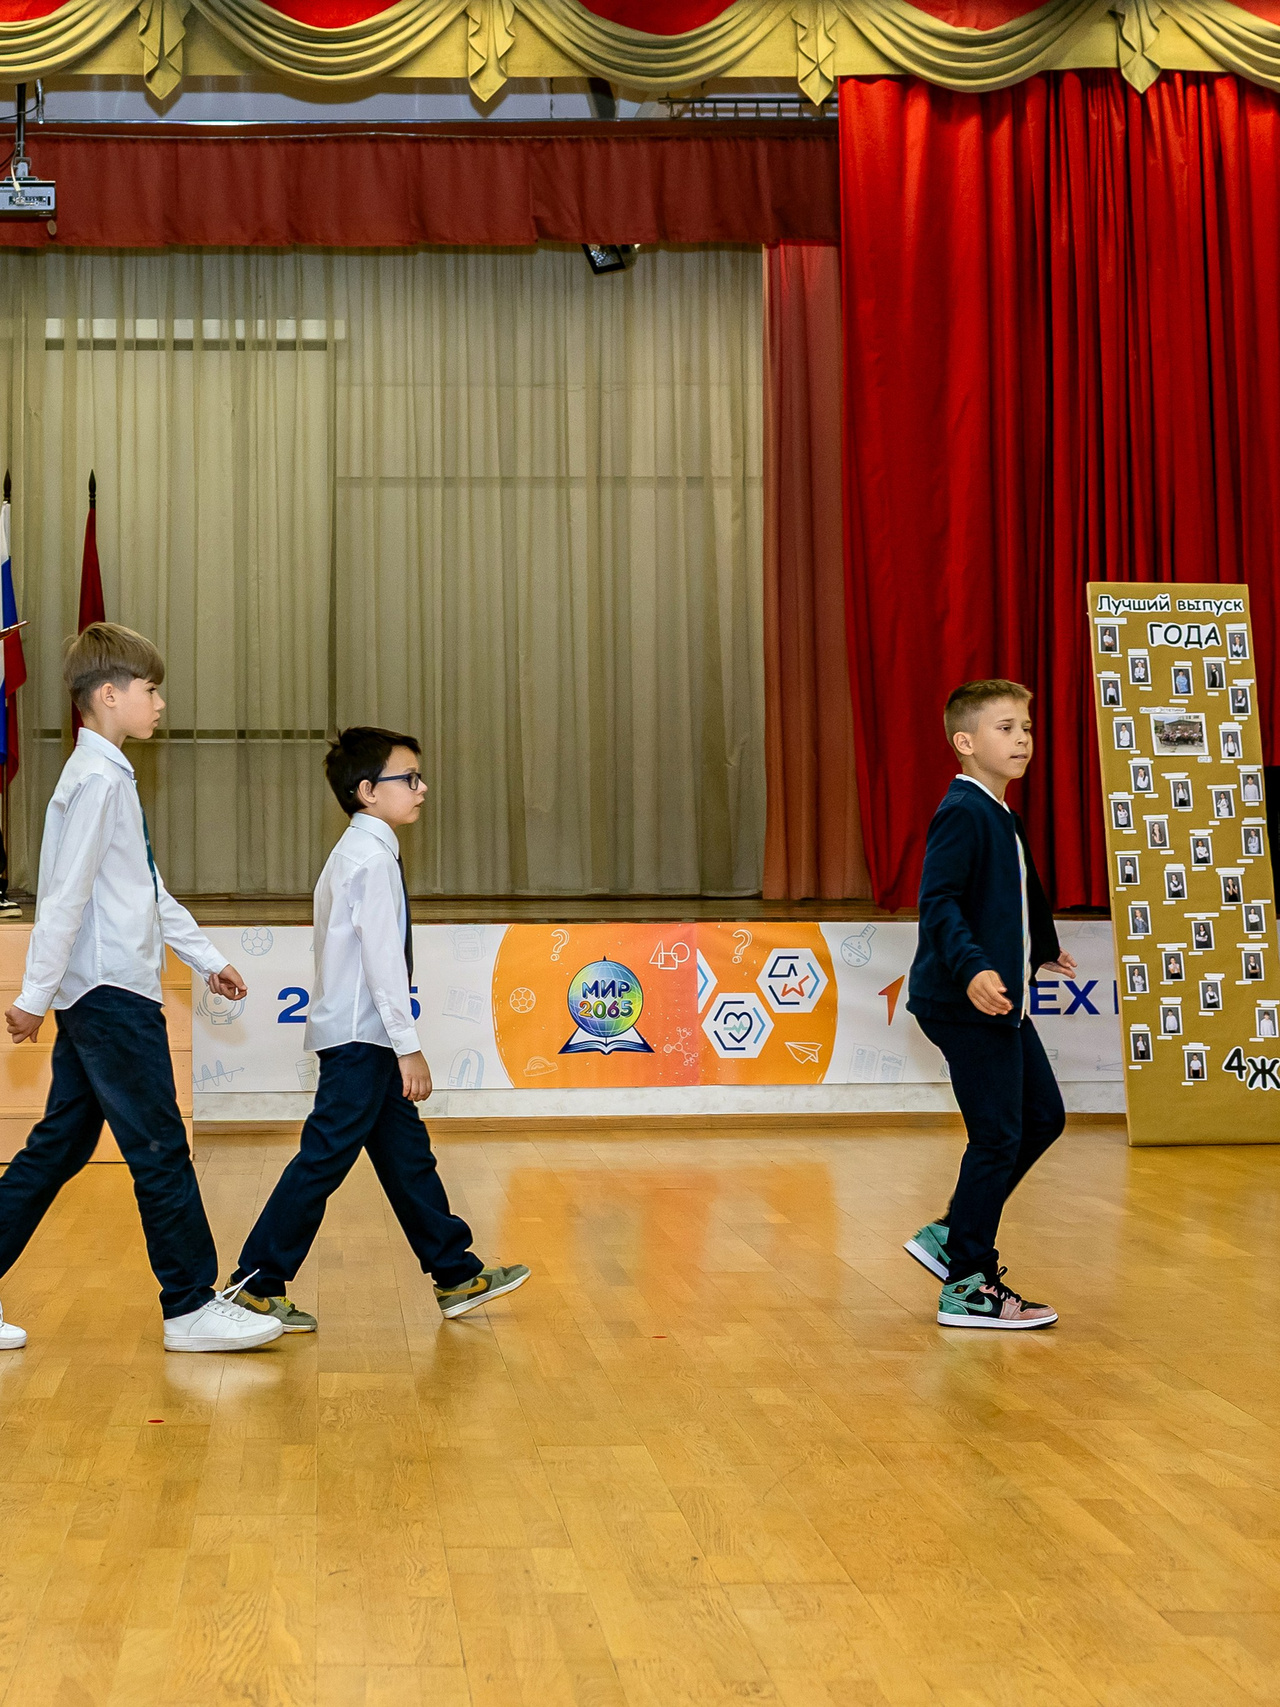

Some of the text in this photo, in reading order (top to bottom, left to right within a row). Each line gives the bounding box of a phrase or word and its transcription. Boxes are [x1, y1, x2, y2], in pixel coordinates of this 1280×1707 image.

[1098, 595, 1243, 616] Лучший выпуск
[1149, 623, 1220, 648] ГОДА
[581, 979, 631, 999] МИР
[579, 999, 634, 1020] 2065
